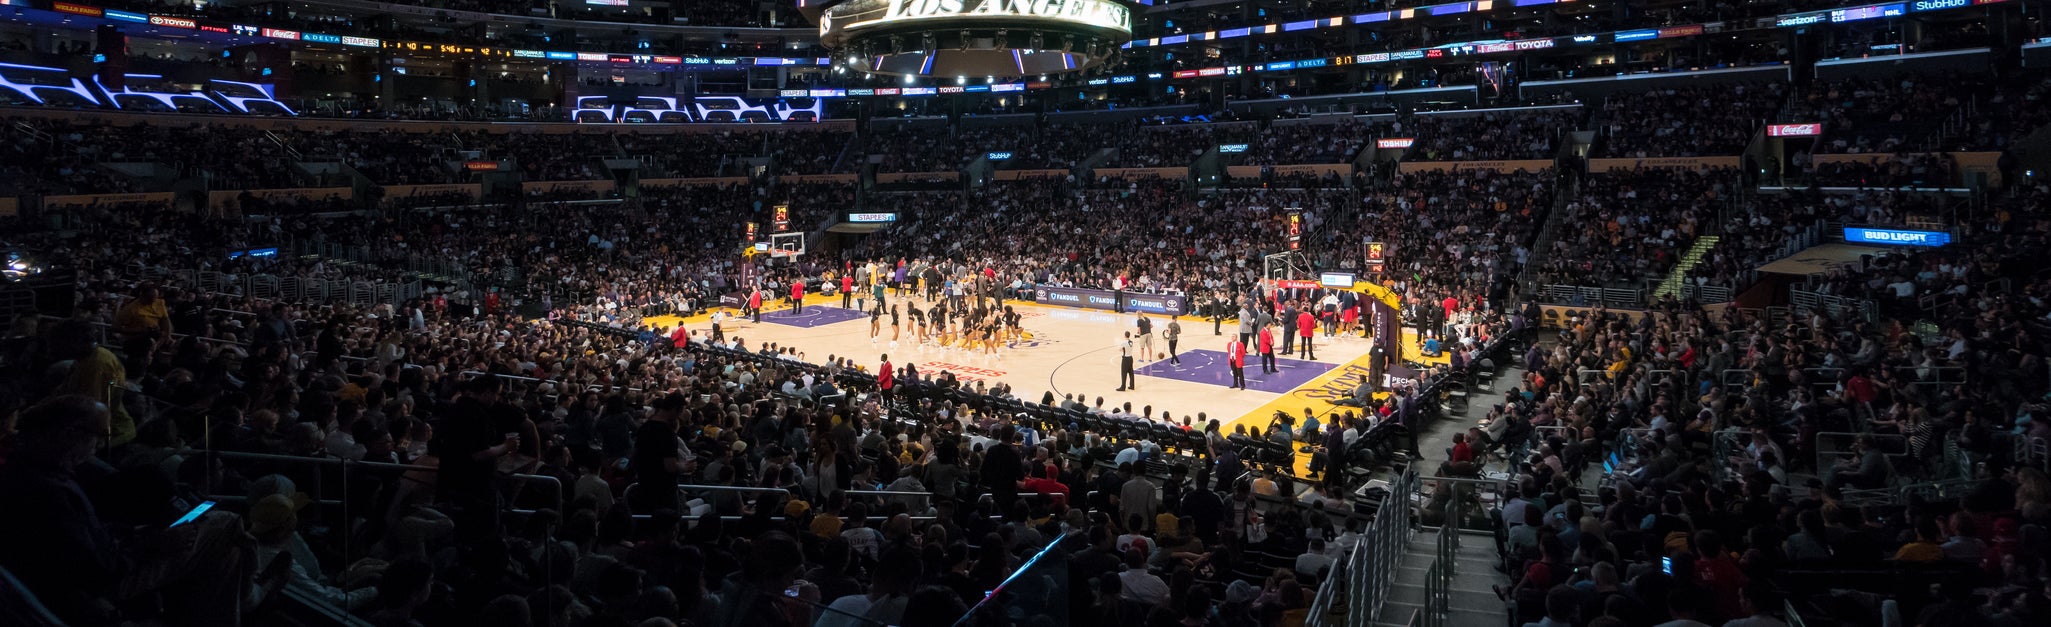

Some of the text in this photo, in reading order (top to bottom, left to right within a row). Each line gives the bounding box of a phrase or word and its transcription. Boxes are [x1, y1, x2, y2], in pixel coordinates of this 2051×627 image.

[884, 0, 964, 18] LOS
[164, 18, 196, 28] TOYOTA
[1780, 14, 1818, 26] verizon
[343, 37, 379, 47] STAPLES
[406, 42, 417, 50] 40
[1515, 40, 1553, 49] TOYOTA
[480, 47, 490, 55] 42
[1303, 59, 1326, 67] DELTA
[1357, 54, 1389, 63] STAPLES
[1781, 126, 1815, 135] Coca-Cola
[776, 212, 786, 221] 24
[1864, 231, 1927, 243] BUD LIGHT
[1370, 250, 1380, 258] 24
[1056, 294, 1080, 302] FANDUEL
[1137, 300, 1164, 309] FANDUEL
[1375, 312, 1383, 340] PECHANG
[922, 361, 1008, 377] STAPLES
